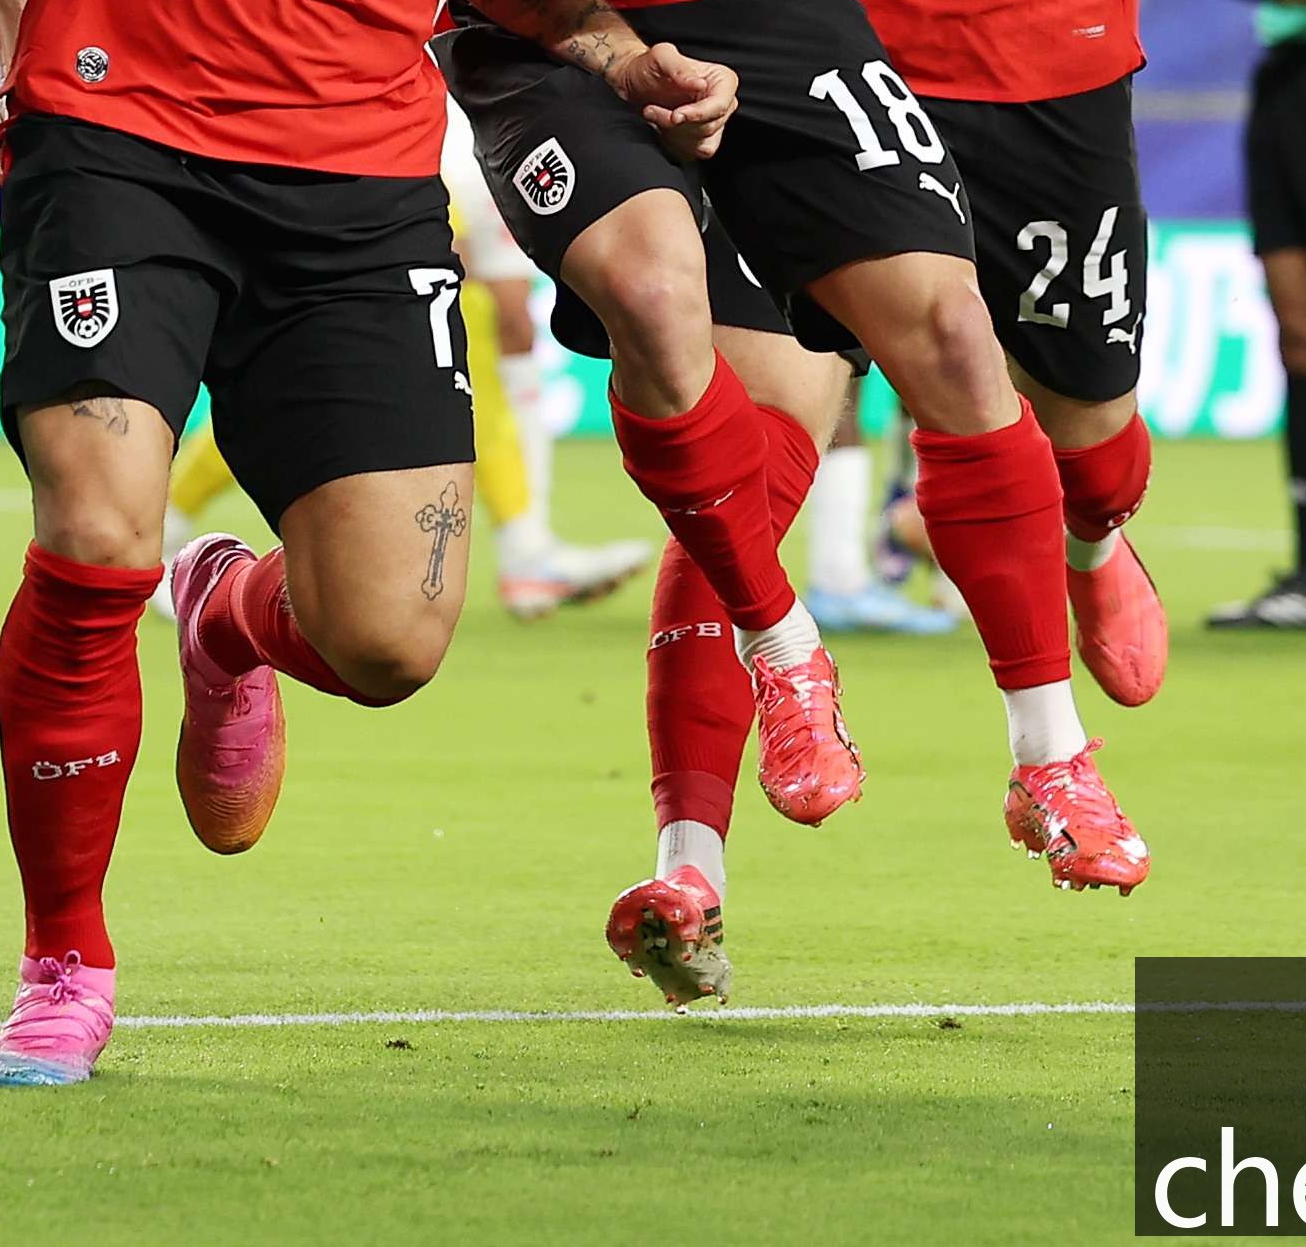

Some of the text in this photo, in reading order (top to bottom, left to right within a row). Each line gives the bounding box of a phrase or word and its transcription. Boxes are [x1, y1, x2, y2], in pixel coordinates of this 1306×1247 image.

[808, 59, 945, 171] 18
[408, 267, 460, 369] 7
[1016, 206, 1131, 329] 24
[32, 750, 122, 780] ÖFB
